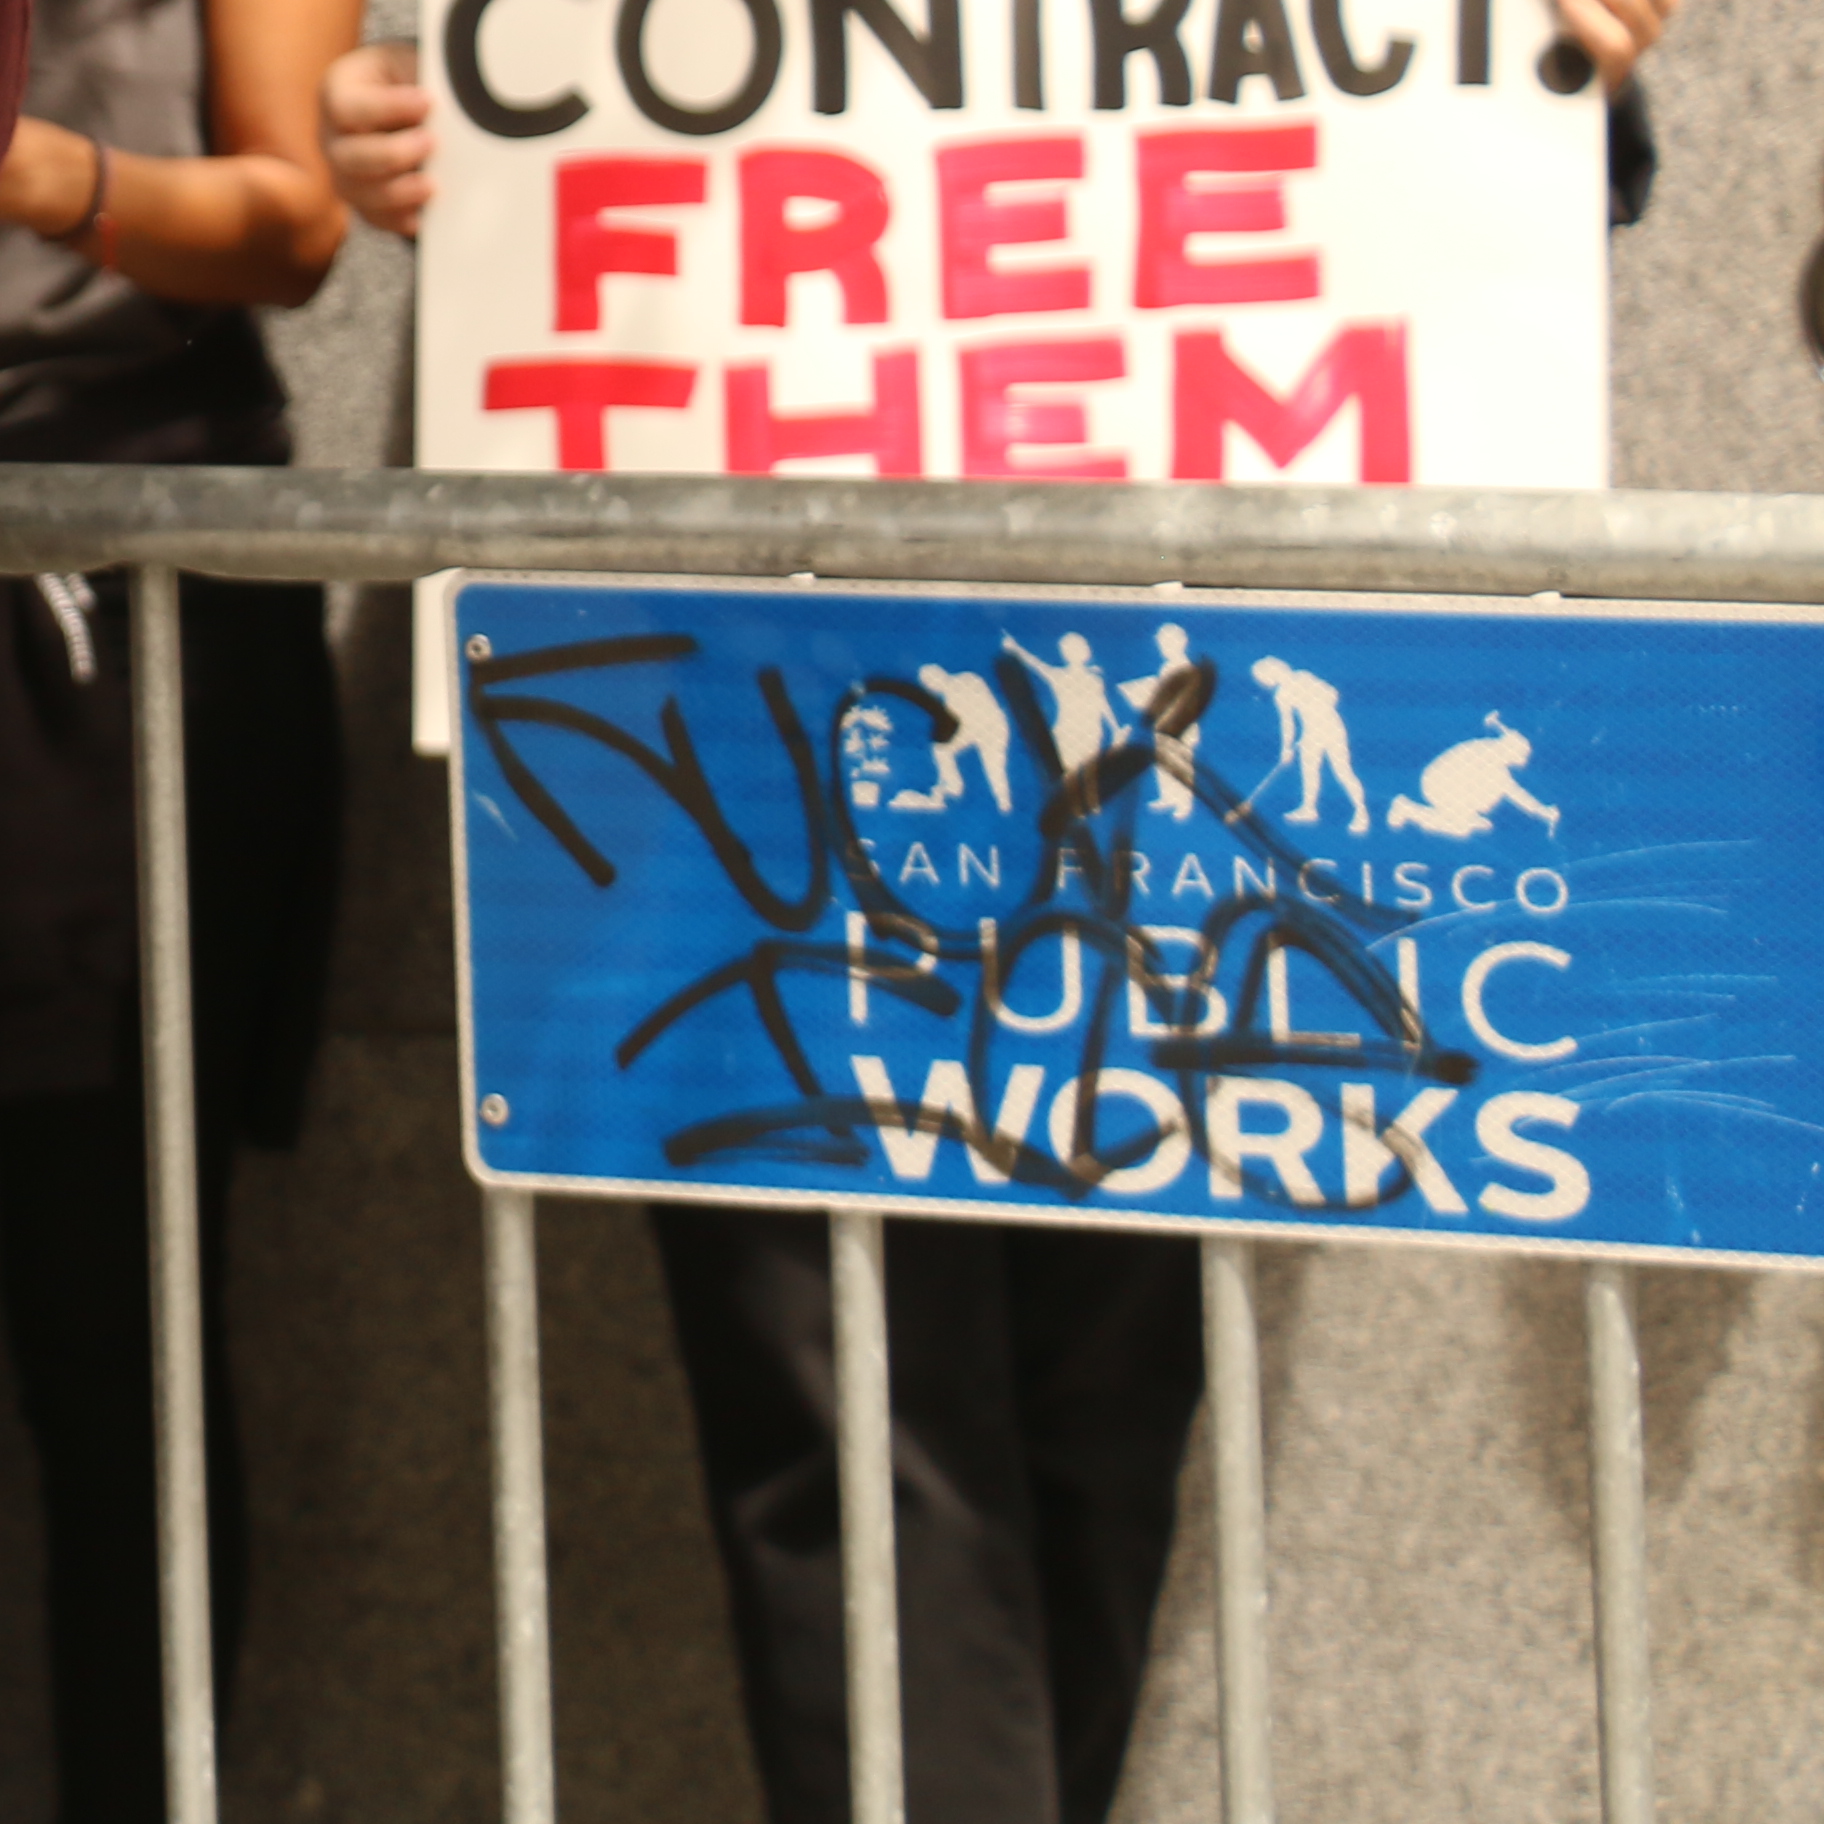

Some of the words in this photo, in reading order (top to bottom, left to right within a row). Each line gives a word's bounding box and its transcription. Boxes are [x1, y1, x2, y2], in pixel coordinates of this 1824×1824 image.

[552, 121, 1323, 332] FREE
[481, 319, 1412, 486] THEM
[846, 834, 1002, 889] SAN
[1056, 845, 1569, 913] FRANCISCO
[846, 911, 1578, 1060] PUBLIC
[850, 1054, 1591, 1222] WORKS
